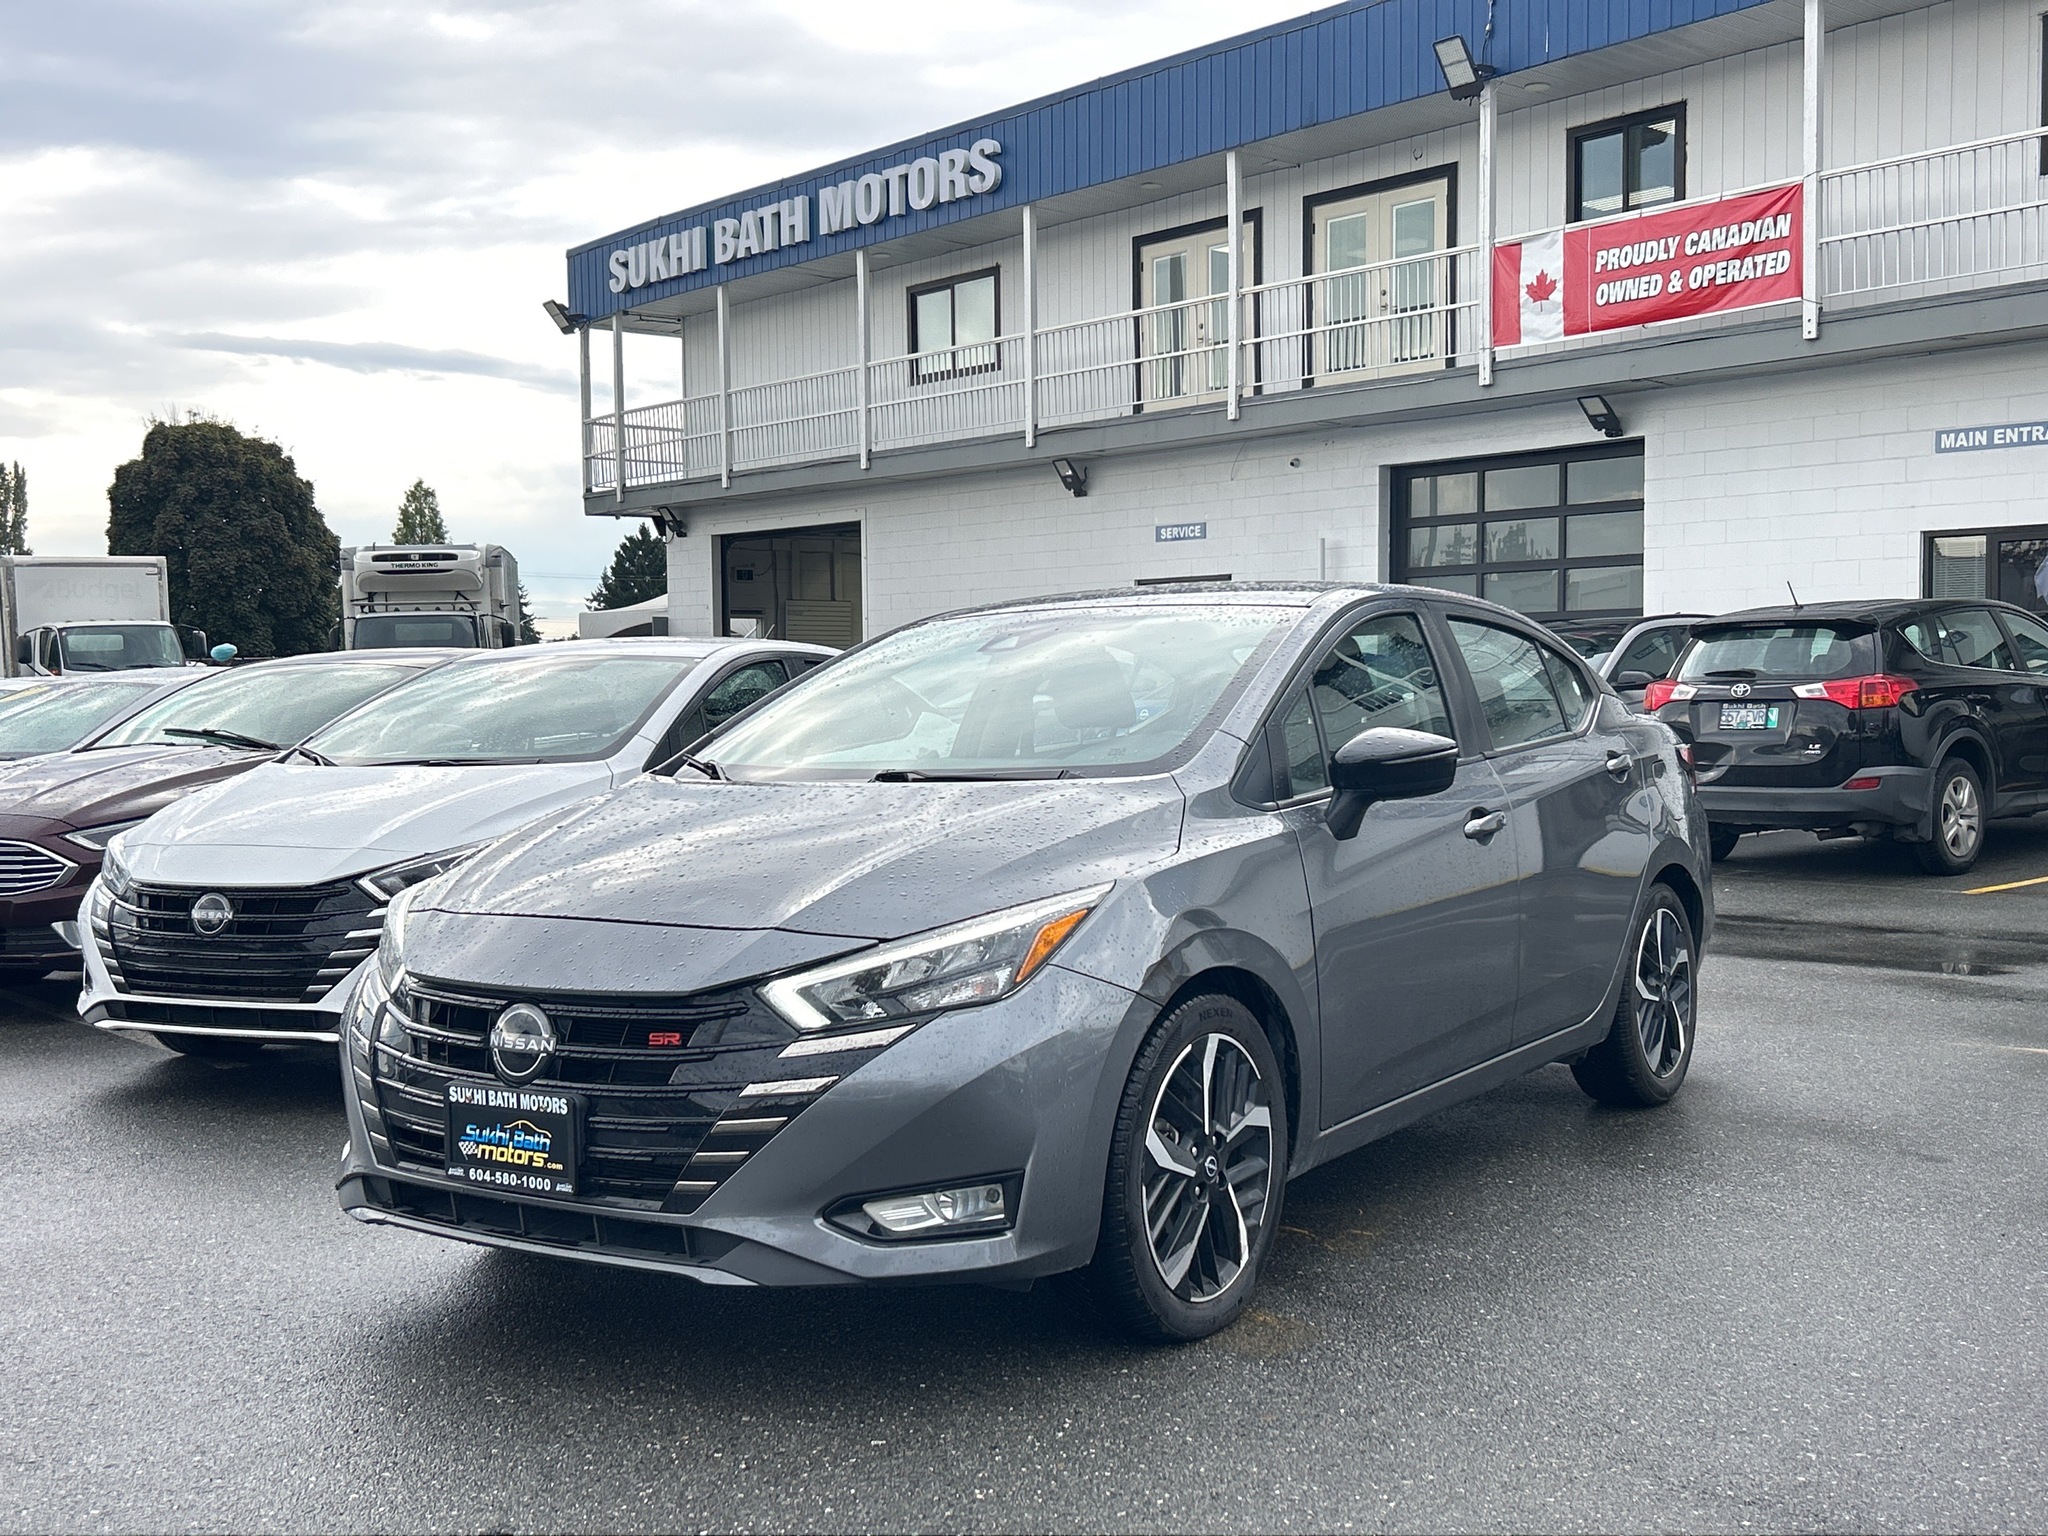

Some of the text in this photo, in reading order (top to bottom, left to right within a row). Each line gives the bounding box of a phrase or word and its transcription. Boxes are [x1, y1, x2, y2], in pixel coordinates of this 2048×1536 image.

[608, 138, 1002, 294] SUKHI BATH MOTORS
[1594, 213, 1792, 273] PROUDLY CANADIAN
[1595, 250, 1792, 306] OWNED & OPERATED
[1940, 425, 2048, 449] MAIN ENTR
[1160, 525, 1201, 539] SERVICE
[1199, 1008, 1233, 1021] NEXEN
[490, 1032, 554, 1051] NISSAN
[648, 1032, 681, 1045] SR
[449, 1086, 568, 1115] SUKHI BATH MOTORS
[461, 1123, 551, 1152] Sukhi Bath
[469, 1167, 551, 1191] 604-580-1000
